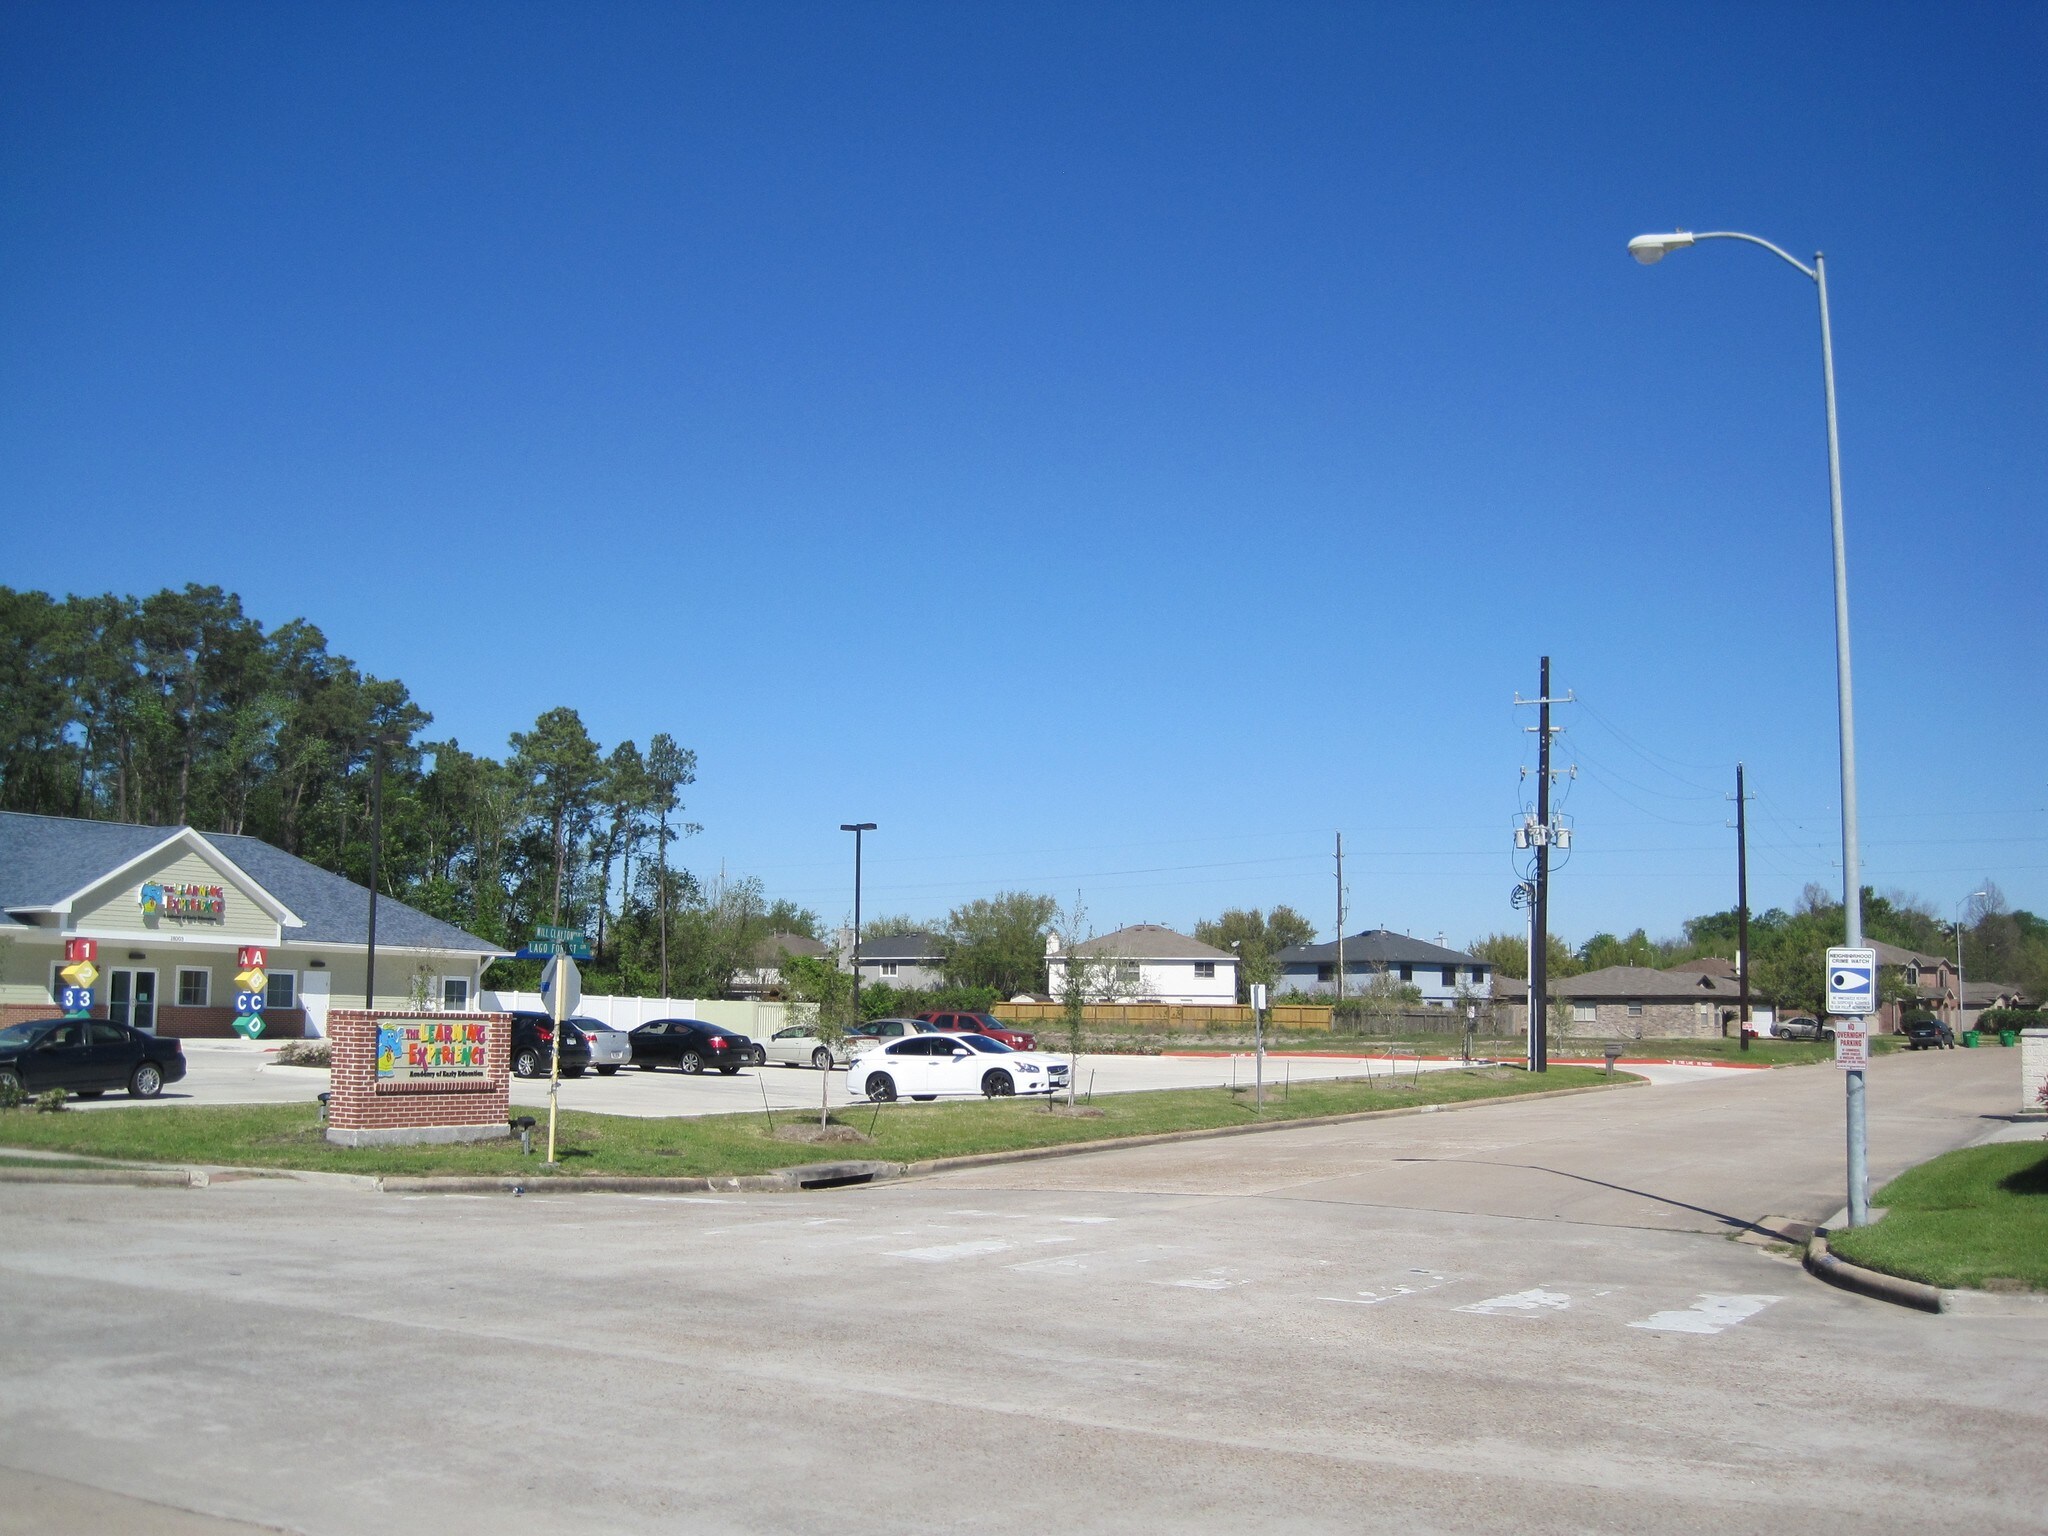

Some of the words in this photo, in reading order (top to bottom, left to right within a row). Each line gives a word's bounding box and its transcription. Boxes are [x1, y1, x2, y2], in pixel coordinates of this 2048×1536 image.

[174, 883, 224, 899] LEARNING
[537, 926, 549, 938] WILL
[550, 928, 574, 941] CLAYTON
[83, 942, 90, 958] 1
[529, 943, 548, 953] LAGO
[551, 943, 577, 954] FORST
[252, 950, 263, 965] A
[65, 990, 74, 1007] 3
[80, 991, 91, 1007] 3
[237, 995, 247, 1010] C
[251, 995, 262, 1010] C
[248, 1016, 261, 1032] D
[1847, 1023, 1855, 1031] NO
[406, 1028, 420, 1040] THE
[420, 1023, 486, 1045] LEARNING
[1836, 1031, 1865, 1039] OVERNIGHT
[1840, 1039, 1862, 1047] PARKING
[409, 1043, 486, 1072] EXPERIENCE
[457, 1069, 484, 1078] Education
